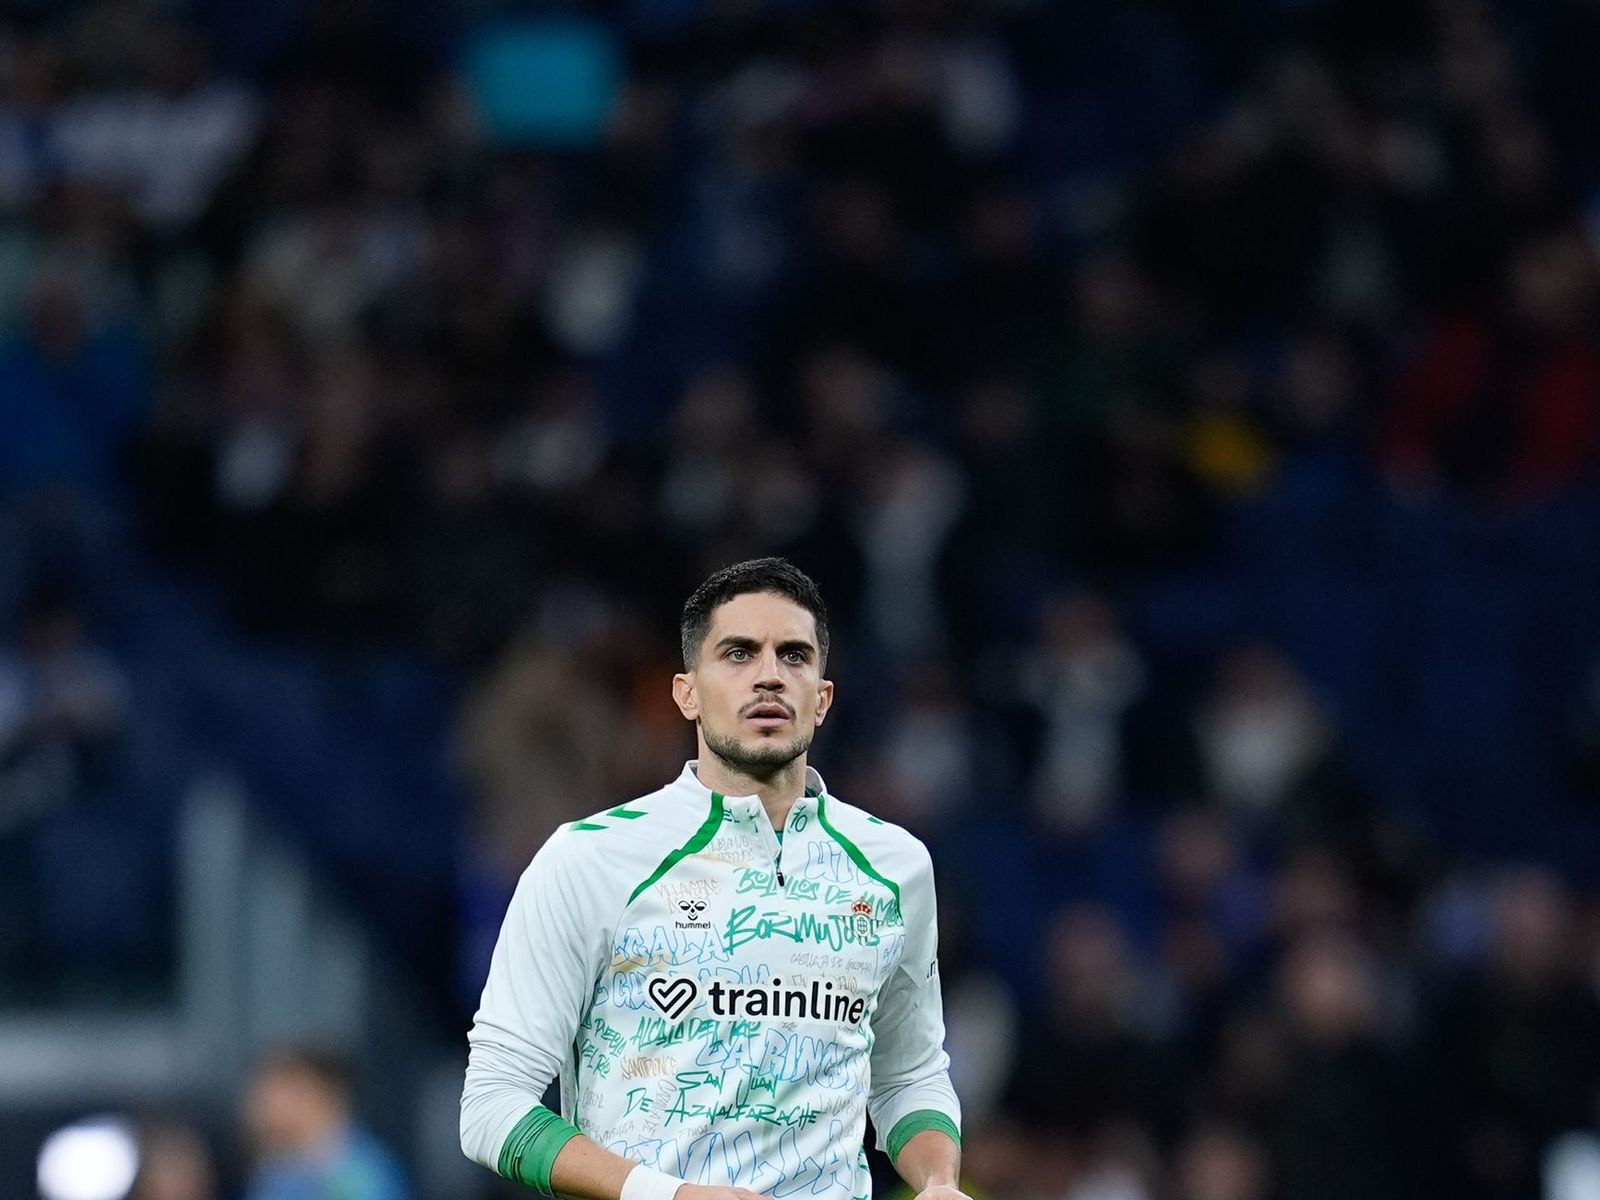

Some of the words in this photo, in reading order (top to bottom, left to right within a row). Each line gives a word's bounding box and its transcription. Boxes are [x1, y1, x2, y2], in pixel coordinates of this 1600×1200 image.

[675, 920, 711, 929] hummel
[708, 978, 865, 1024] trainline
[623, 1087, 654, 1118] DE
[675, 1070, 726, 1094] SAN
[735, 1063, 779, 1108] JUAN
